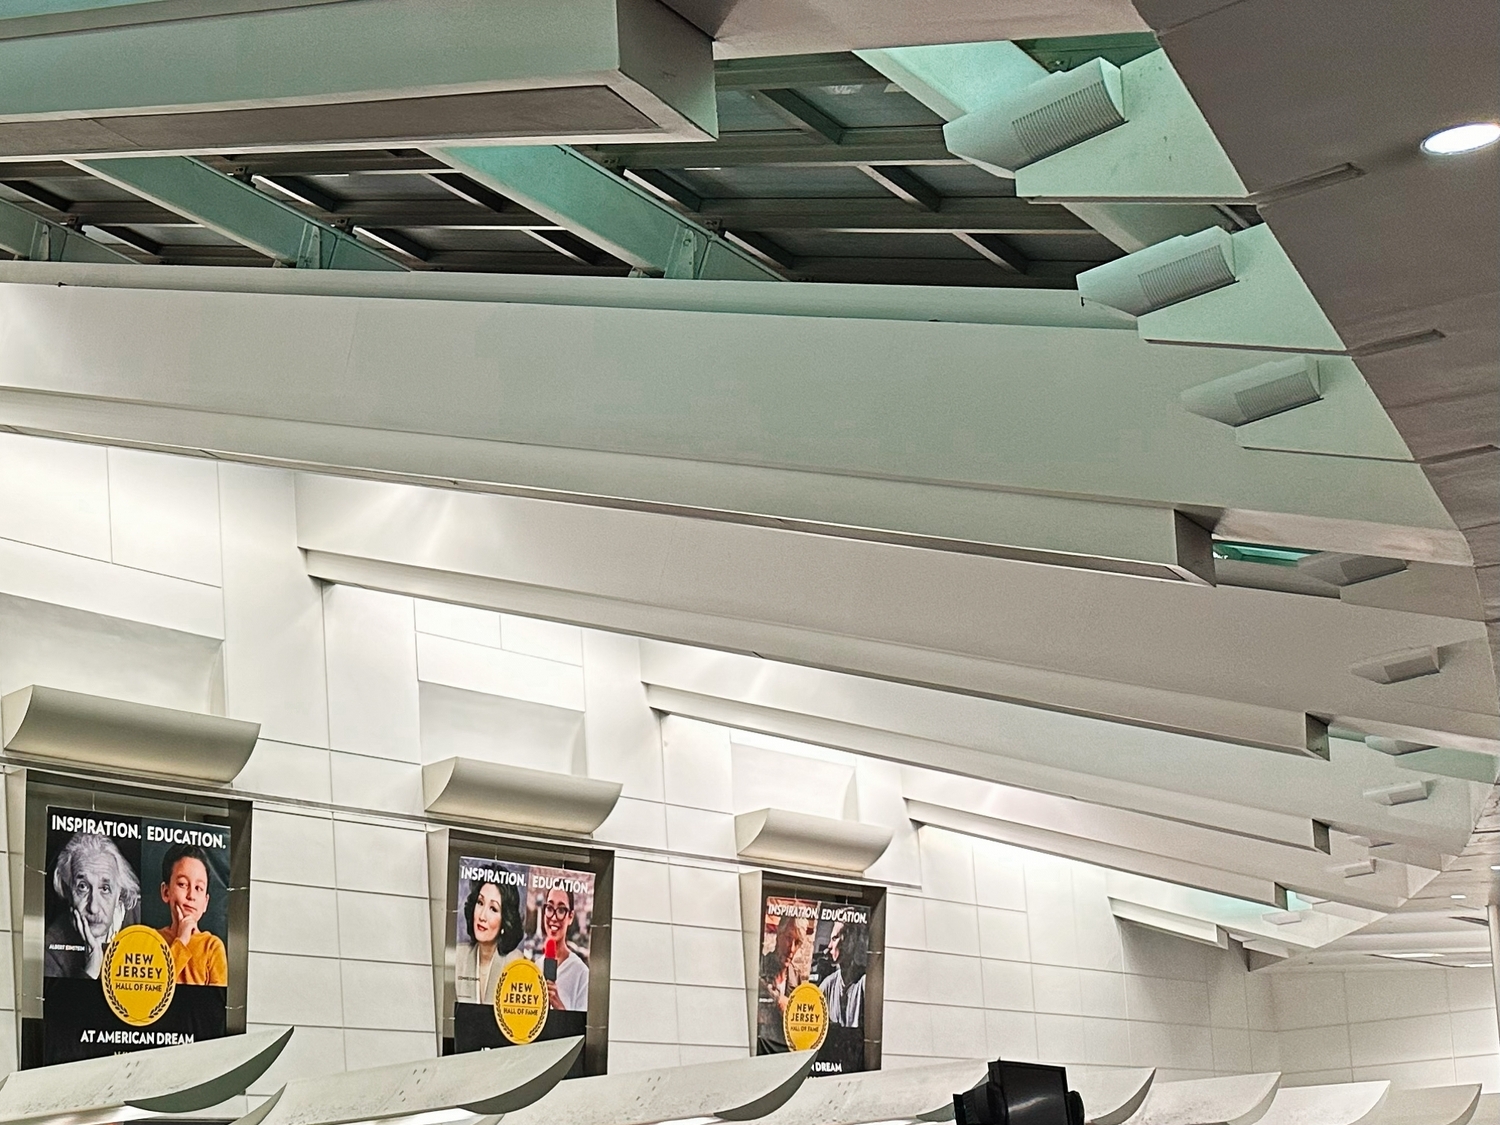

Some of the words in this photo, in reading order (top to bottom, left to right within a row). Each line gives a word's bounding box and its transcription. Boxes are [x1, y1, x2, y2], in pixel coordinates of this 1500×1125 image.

[51, 814, 142, 839] INSPIRATION.
[147, 826, 227, 849] EDUCATION.
[461, 866, 527, 887] INSPIRATION.
[767, 904, 819, 920] INSPIRATION.
[821, 910, 868, 924] EDUCATION.
[125, 953, 154, 965] NEW
[115, 965, 163, 979] JERSEY
[115, 982, 133, 991] HALL
[133, 983, 144, 991] OF
[144, 984, 162, 992] FAME
[511, 982, 533, 993] NEW
[503, 992, 539, 1005] JERSEY
[503, 1007, 516, 1015] HALL
[796, 1003, 816, 1013] NEW
[790, 1012, 820, 1023] JERSEY
[80, 1030, 96, 1043] AT
[97, 1030, 155, 1045] AMERICAN
[156, 1032, 195, 1046] DREAM
[815, 1061, 842, 1073] DREAM
